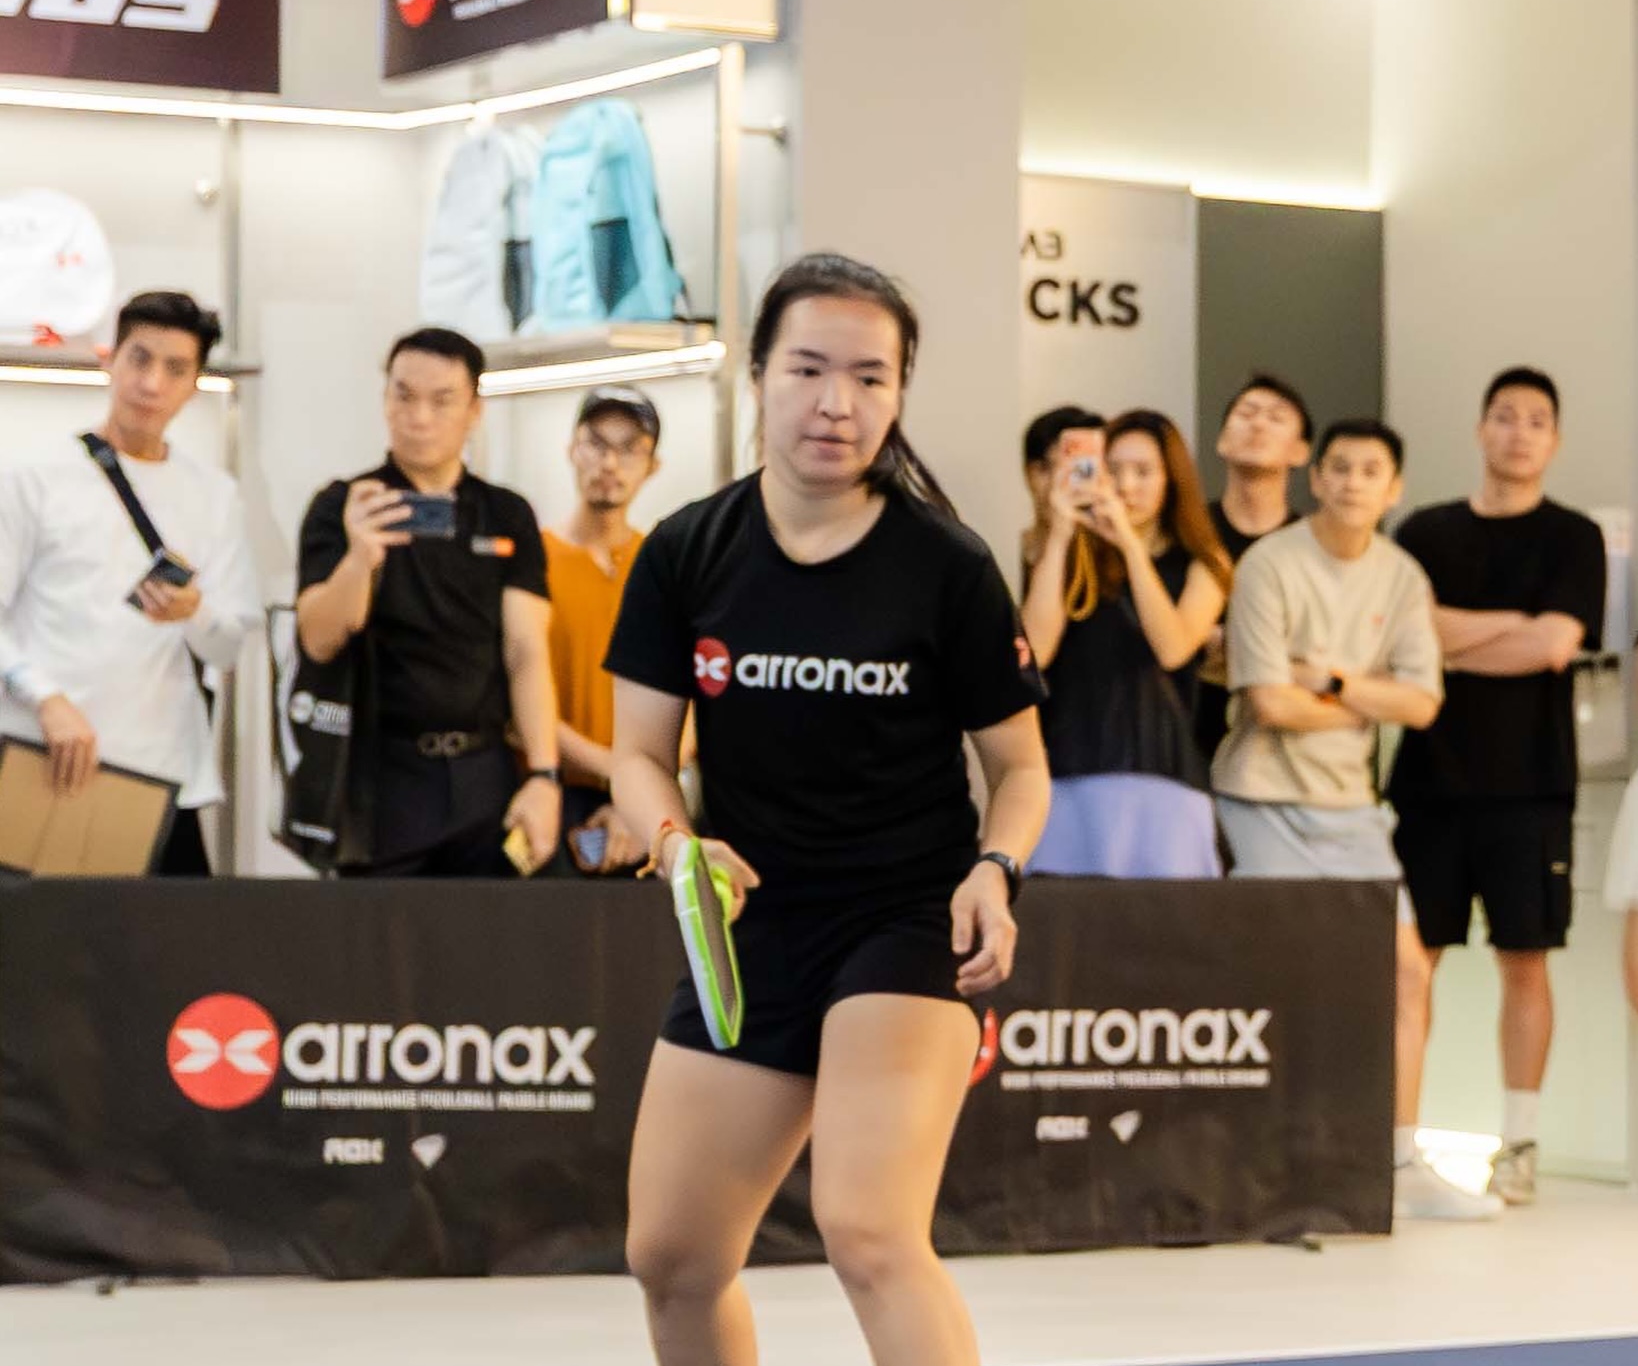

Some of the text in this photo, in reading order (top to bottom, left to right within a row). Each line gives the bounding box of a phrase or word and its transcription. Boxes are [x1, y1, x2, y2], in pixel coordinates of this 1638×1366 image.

[1029, 279, 1139, 327] CKS
[735, 653, 910, 696] arronax
[283, 1021, 597, 1085] arronax
[1000, 1008, 1272, 1065] arronax
